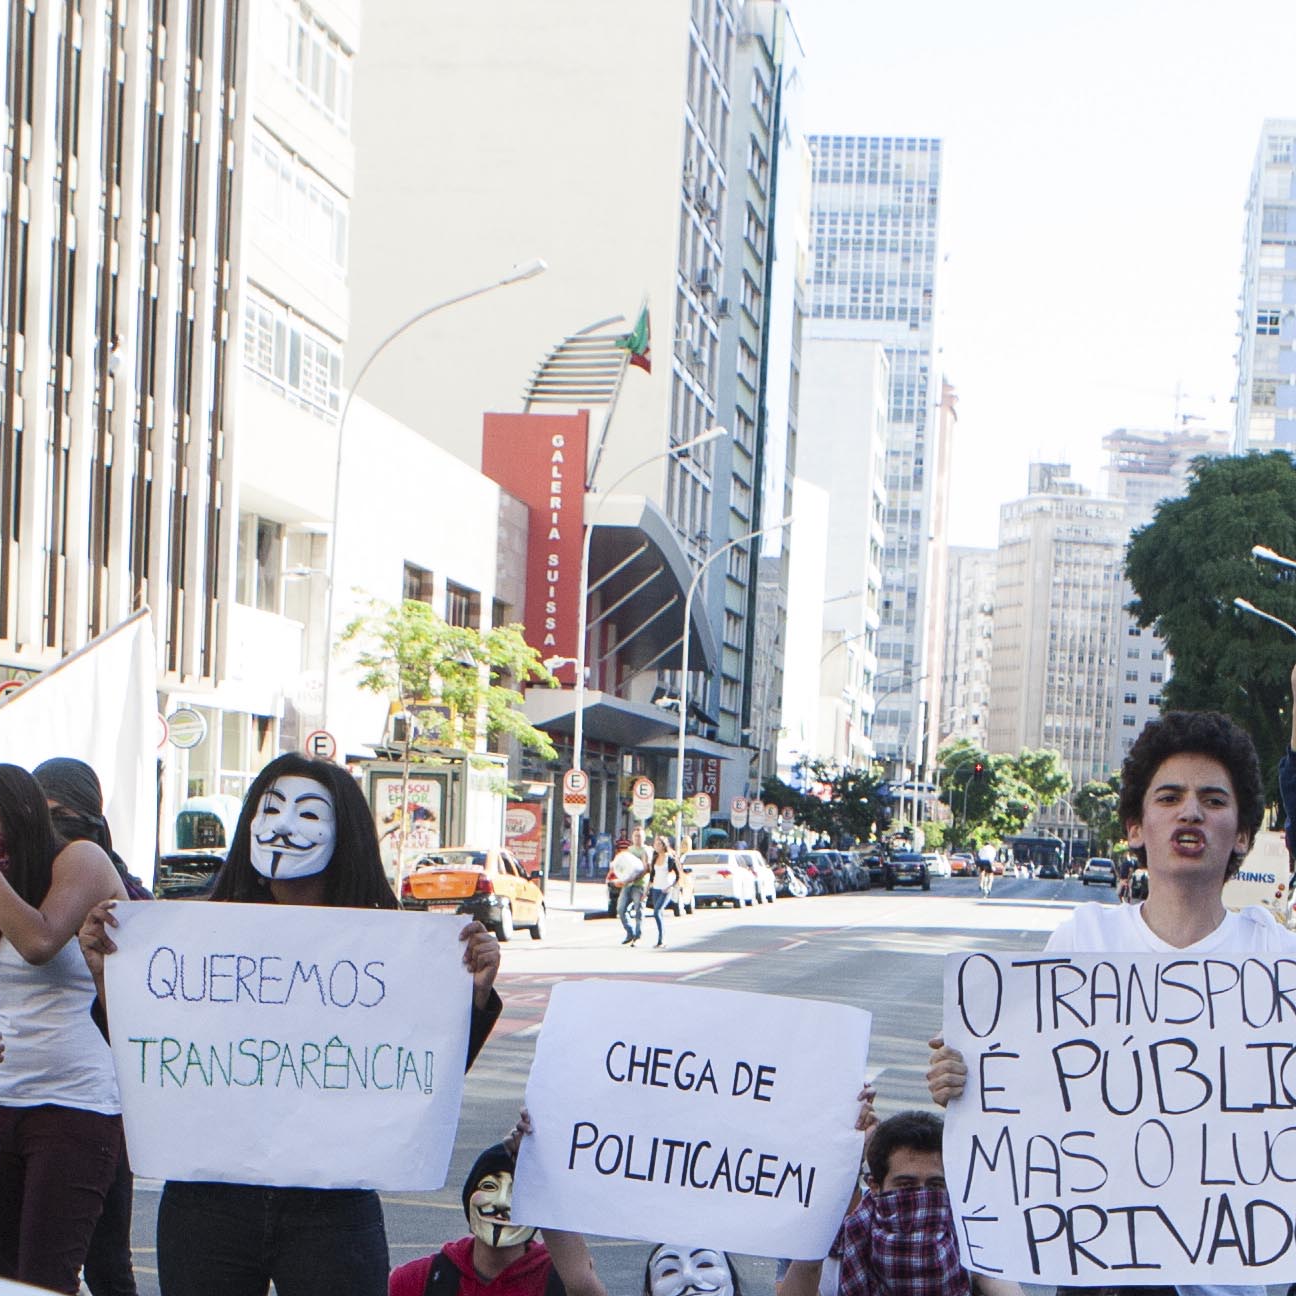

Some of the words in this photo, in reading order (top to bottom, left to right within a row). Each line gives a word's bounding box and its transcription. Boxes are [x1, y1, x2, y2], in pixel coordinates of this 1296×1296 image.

[548, 434, 564, 540] GALERIA
[544, 554, 559, 646] SUISSA
[314, 736, 327, 755] E
[147, 947, 385, 1007] QUEREMOS
[957, 952, 1002, 1037] O
[128, 1035, 434, 1095] TRANSPARÊNCIA!
[605, 1041, 718, 1094] CHEGA
[732, 1061, 777, 1102] DE
[979, 1043, 1021, 1114] É
[568, 1121, 816, 1208] POLITICAGEM!
[963, 1126, 1109, 1206] MAS
[1134, 1118, 1175, 1189] O
[960, 1205, 1003, 1274] É
